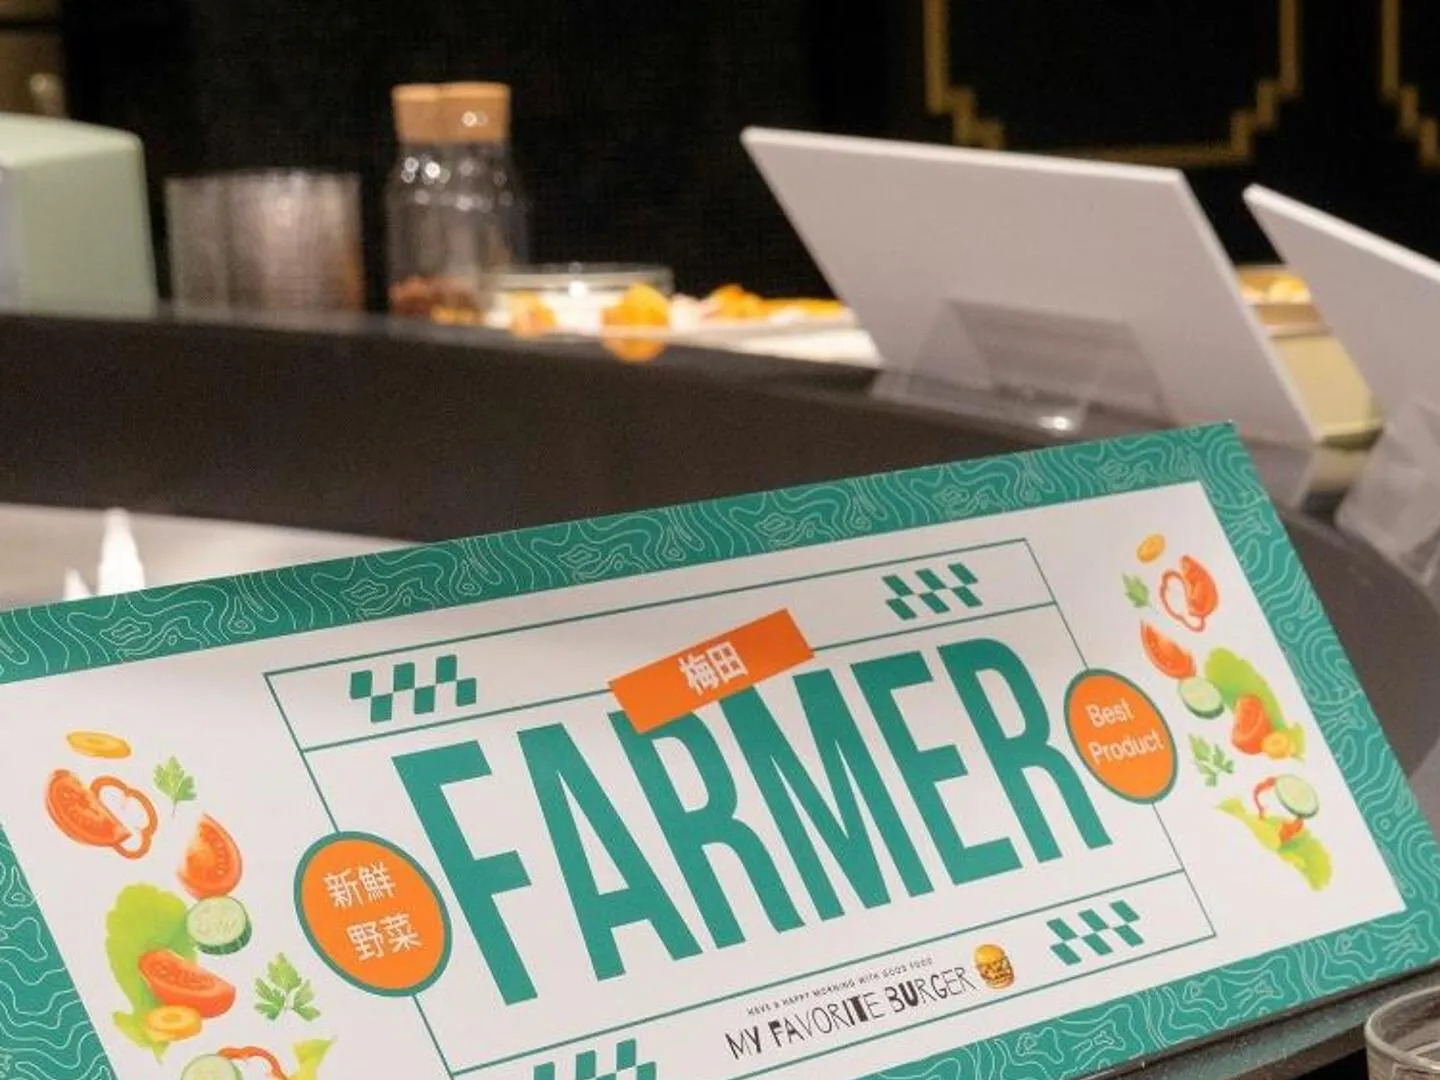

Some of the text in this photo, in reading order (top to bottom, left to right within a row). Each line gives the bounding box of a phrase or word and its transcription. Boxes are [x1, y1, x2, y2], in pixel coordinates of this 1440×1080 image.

[678, 641, 748, 696] 梅田
[1085, 697, 1134, 728] Best
[1088, 729, 1165, 764] Product
[391, 637, 1112, 1006] FARMER
[323, 860, 396, 908] 新鮮
[346, 912, 422, 960] 野菜
[725, 966, 978, 1060] MY FAVORITE BURGER
[747, 1003, 772, 1015] HAVE
[781, 991, 810, 1006] HAPPY
[812, 978, 855, 997] MORNING
[859, 971, 880, 984] WITH
[881, 964, 907, 978] GOOD
